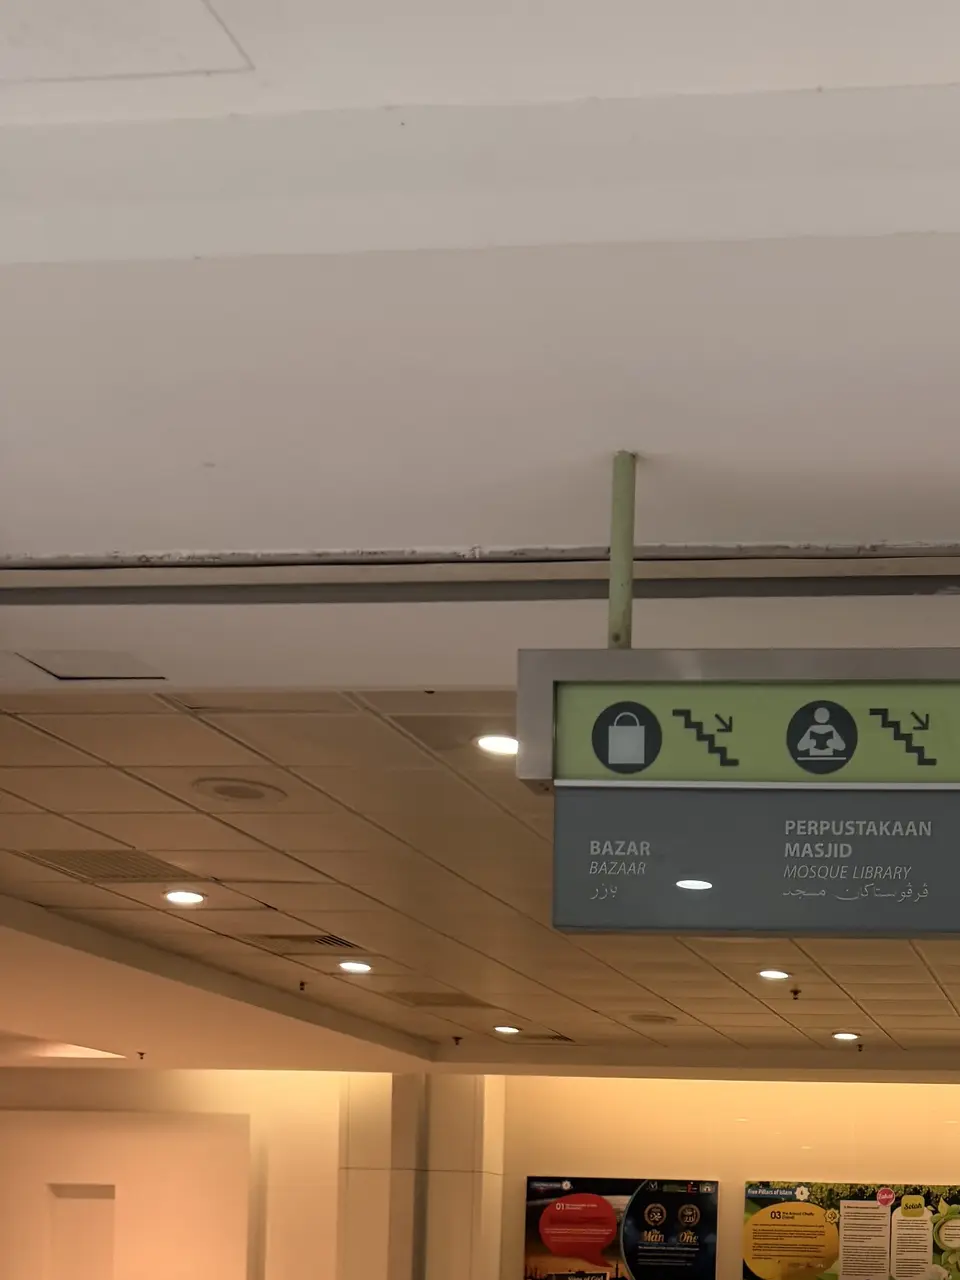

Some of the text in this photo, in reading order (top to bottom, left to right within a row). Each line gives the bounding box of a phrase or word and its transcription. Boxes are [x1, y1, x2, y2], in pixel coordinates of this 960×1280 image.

[785, 820, 932, 836] PERPUSTAKAAN
[589, 840, 651, 856] BAZAR
[784, 842, 853, 858] MASJID
[589, 861, 646, 875] BAZAAR
[783, 865, 912, 880] MOSQUE LIBRARY
[770, 1210, 782, 1219] 03
[679, 1231, 699, 1243] One
